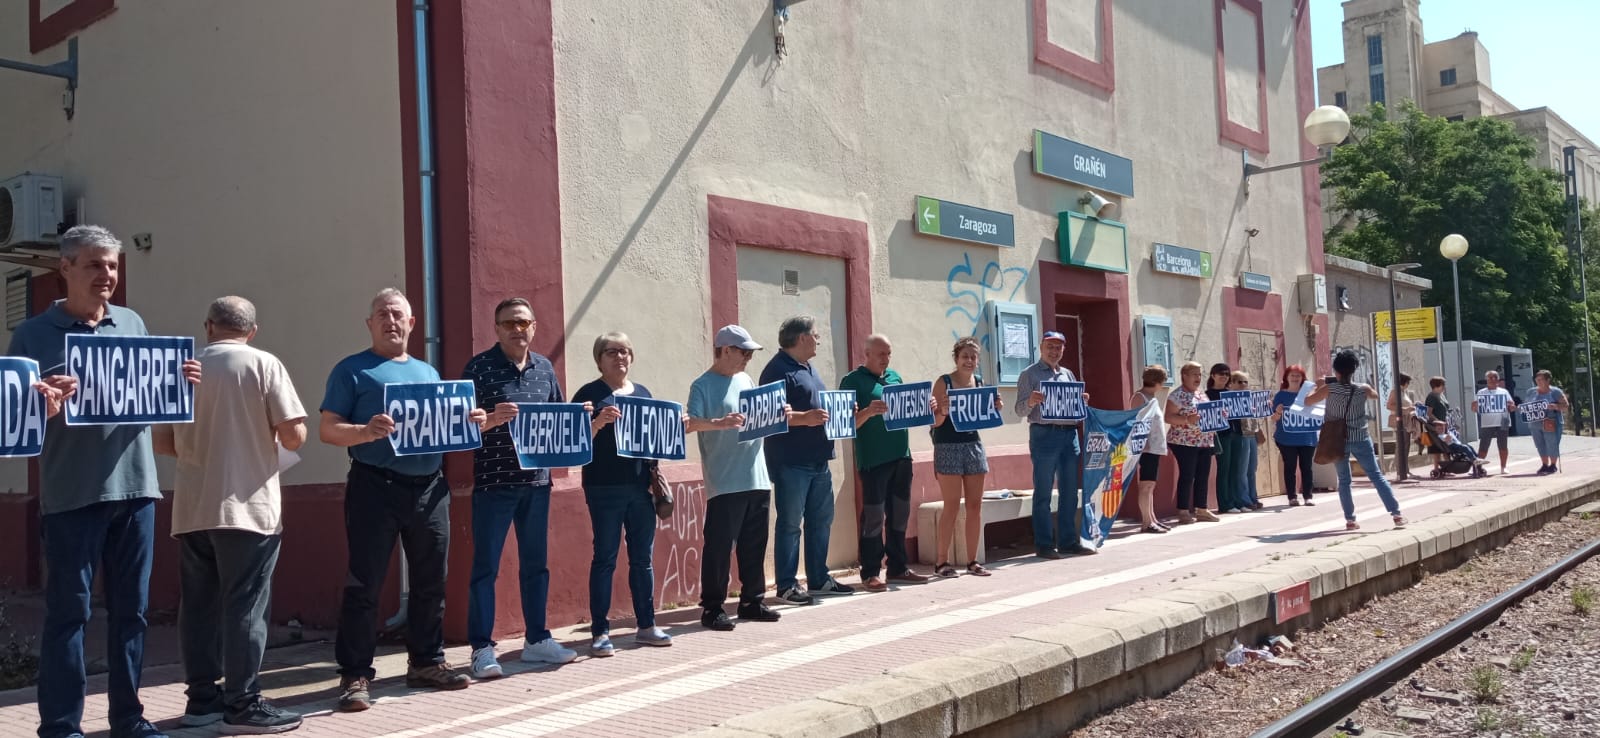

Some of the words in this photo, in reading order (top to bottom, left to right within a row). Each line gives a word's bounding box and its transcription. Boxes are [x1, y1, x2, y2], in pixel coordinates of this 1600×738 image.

[1073, 154, 1107, 178] GRAÑÉN
[959, 214, 998, 235] Zaragoza
[68, 345, 190, 417] SANGARREN
[0, 370, 43, 447] DA
[738, 387, 787, 432] BARBUES
[824, 393, 853, 437] CURBE
[949, 393, 999, 422] FRULA
[1041, 386, 1085, 417] SANGARREN
[1478, 394, 1505, 413] FRAELLA
[1520, 401, 1548, 415] ALBERO
[1526, 410, 1545, 421] BAJO
[513, 412, 589, 454] ALBERUELA
[615, 403, 685, 456] VALFONDA
